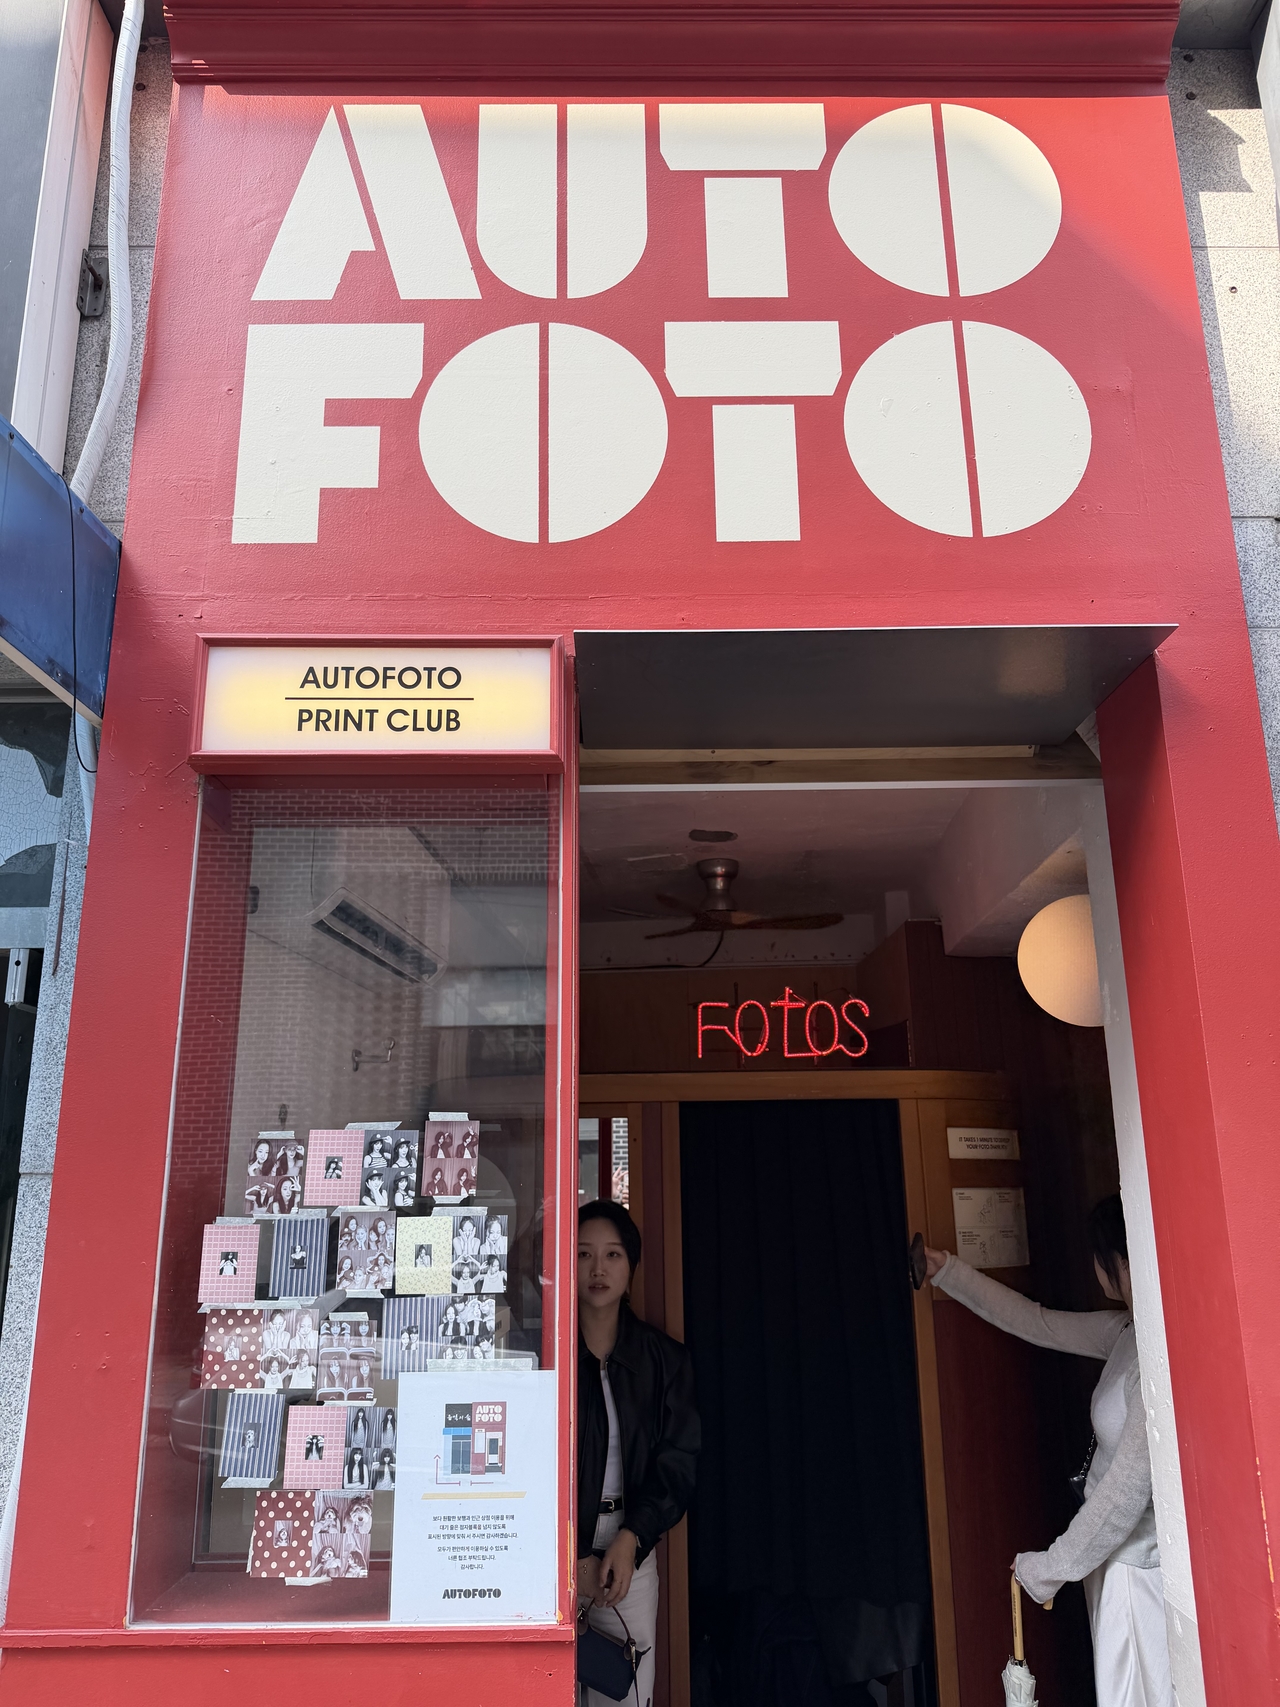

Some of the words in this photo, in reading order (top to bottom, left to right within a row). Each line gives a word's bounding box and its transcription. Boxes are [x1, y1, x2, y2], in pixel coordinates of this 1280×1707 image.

[250, 103, 1062, 300] AUTO
[231, 320, 1092, 544] FOTO
[300, 666, 462, 689] AUTOFOTO
[297, 709, 379, 732] PRINT
[386, 709, 461, 732] CLUB
[475, 1414, 502, 1422] FOTO
[476, 1405, 502, 1414] AUTO
[442, 1588, 502, 1600] AUTOFOTO
